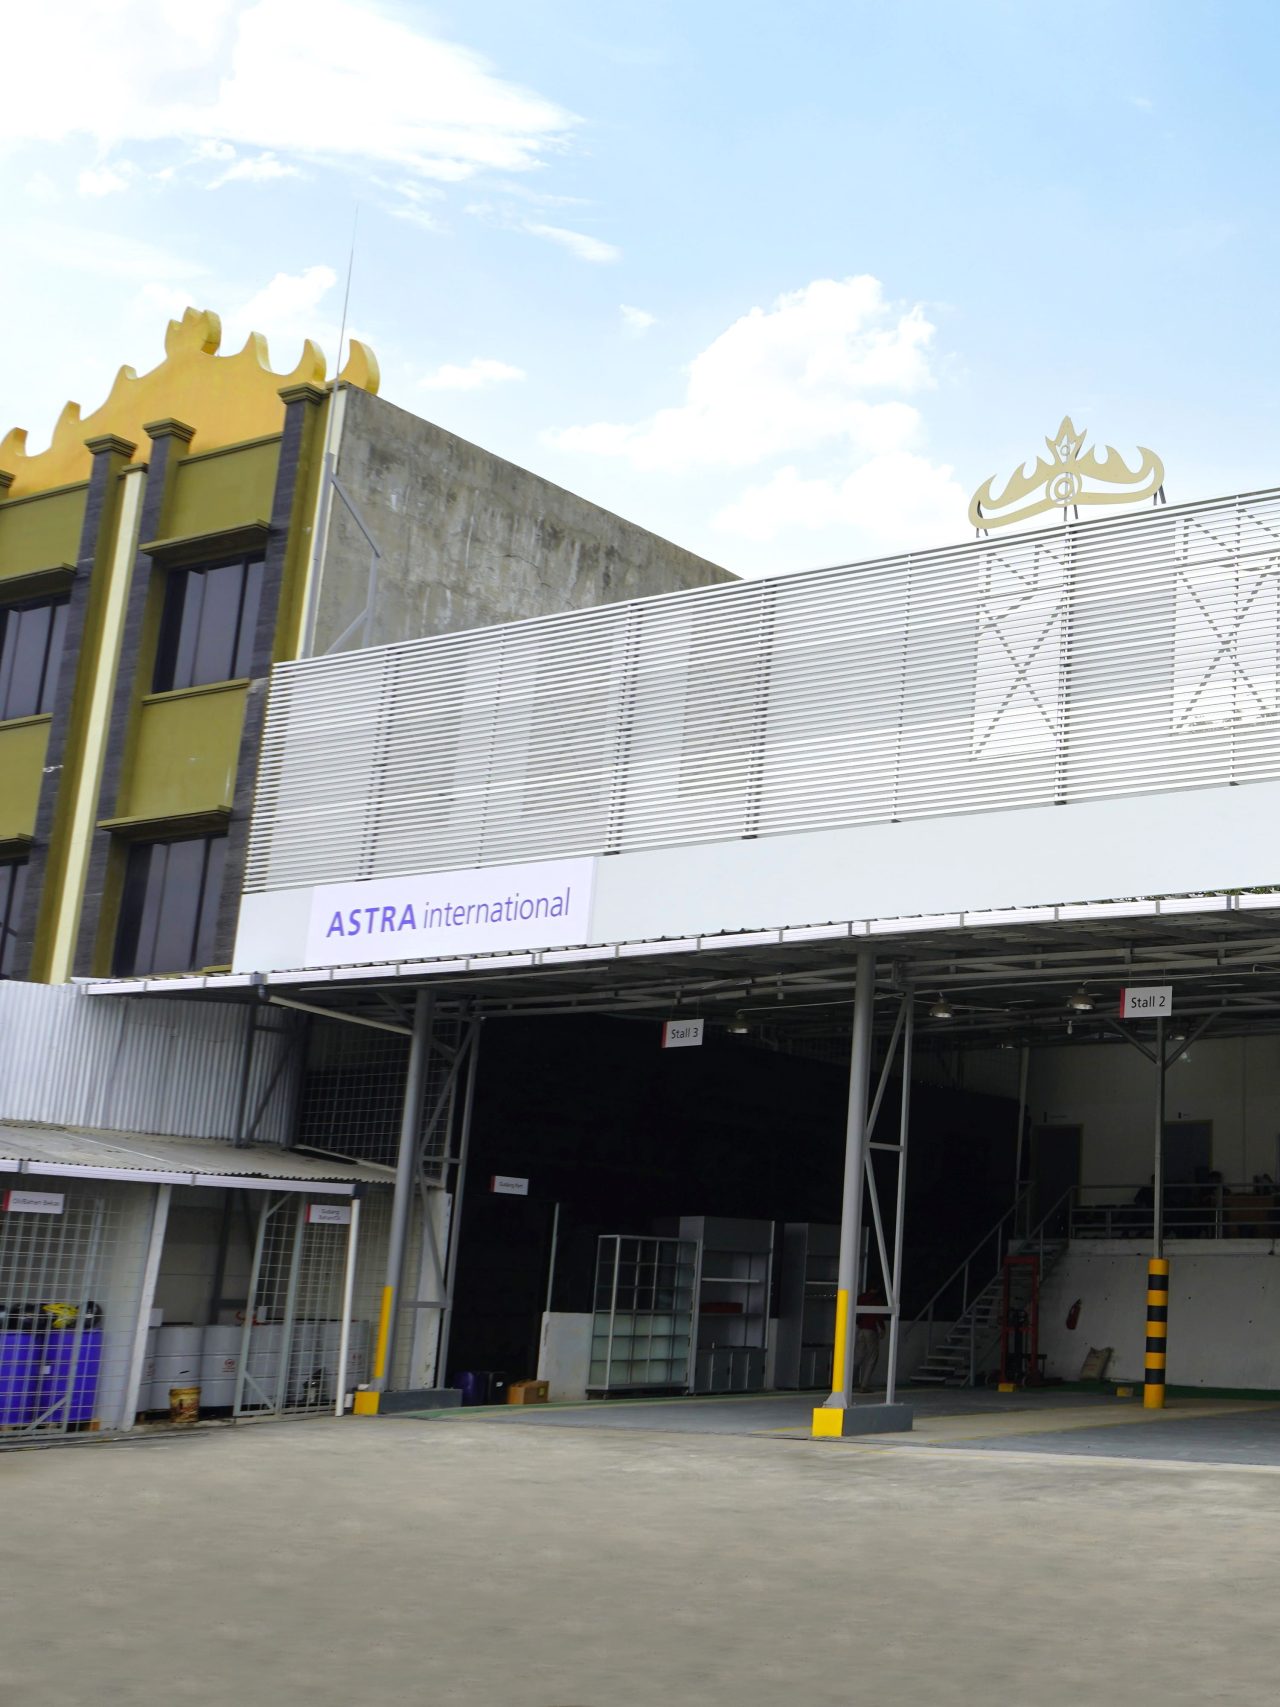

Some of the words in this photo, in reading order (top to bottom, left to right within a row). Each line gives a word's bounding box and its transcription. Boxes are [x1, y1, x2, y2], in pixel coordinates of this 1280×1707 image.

[326, 903, 417, 938] ASTRA
[423, 886, 571, 929] international
[1131, 995, 1155, 1009] Stall
[1159, 995, 1166, 1007] 2
[671, 1027, 691, 1040] Stall
[692, 1027, 699, 1038] 3
